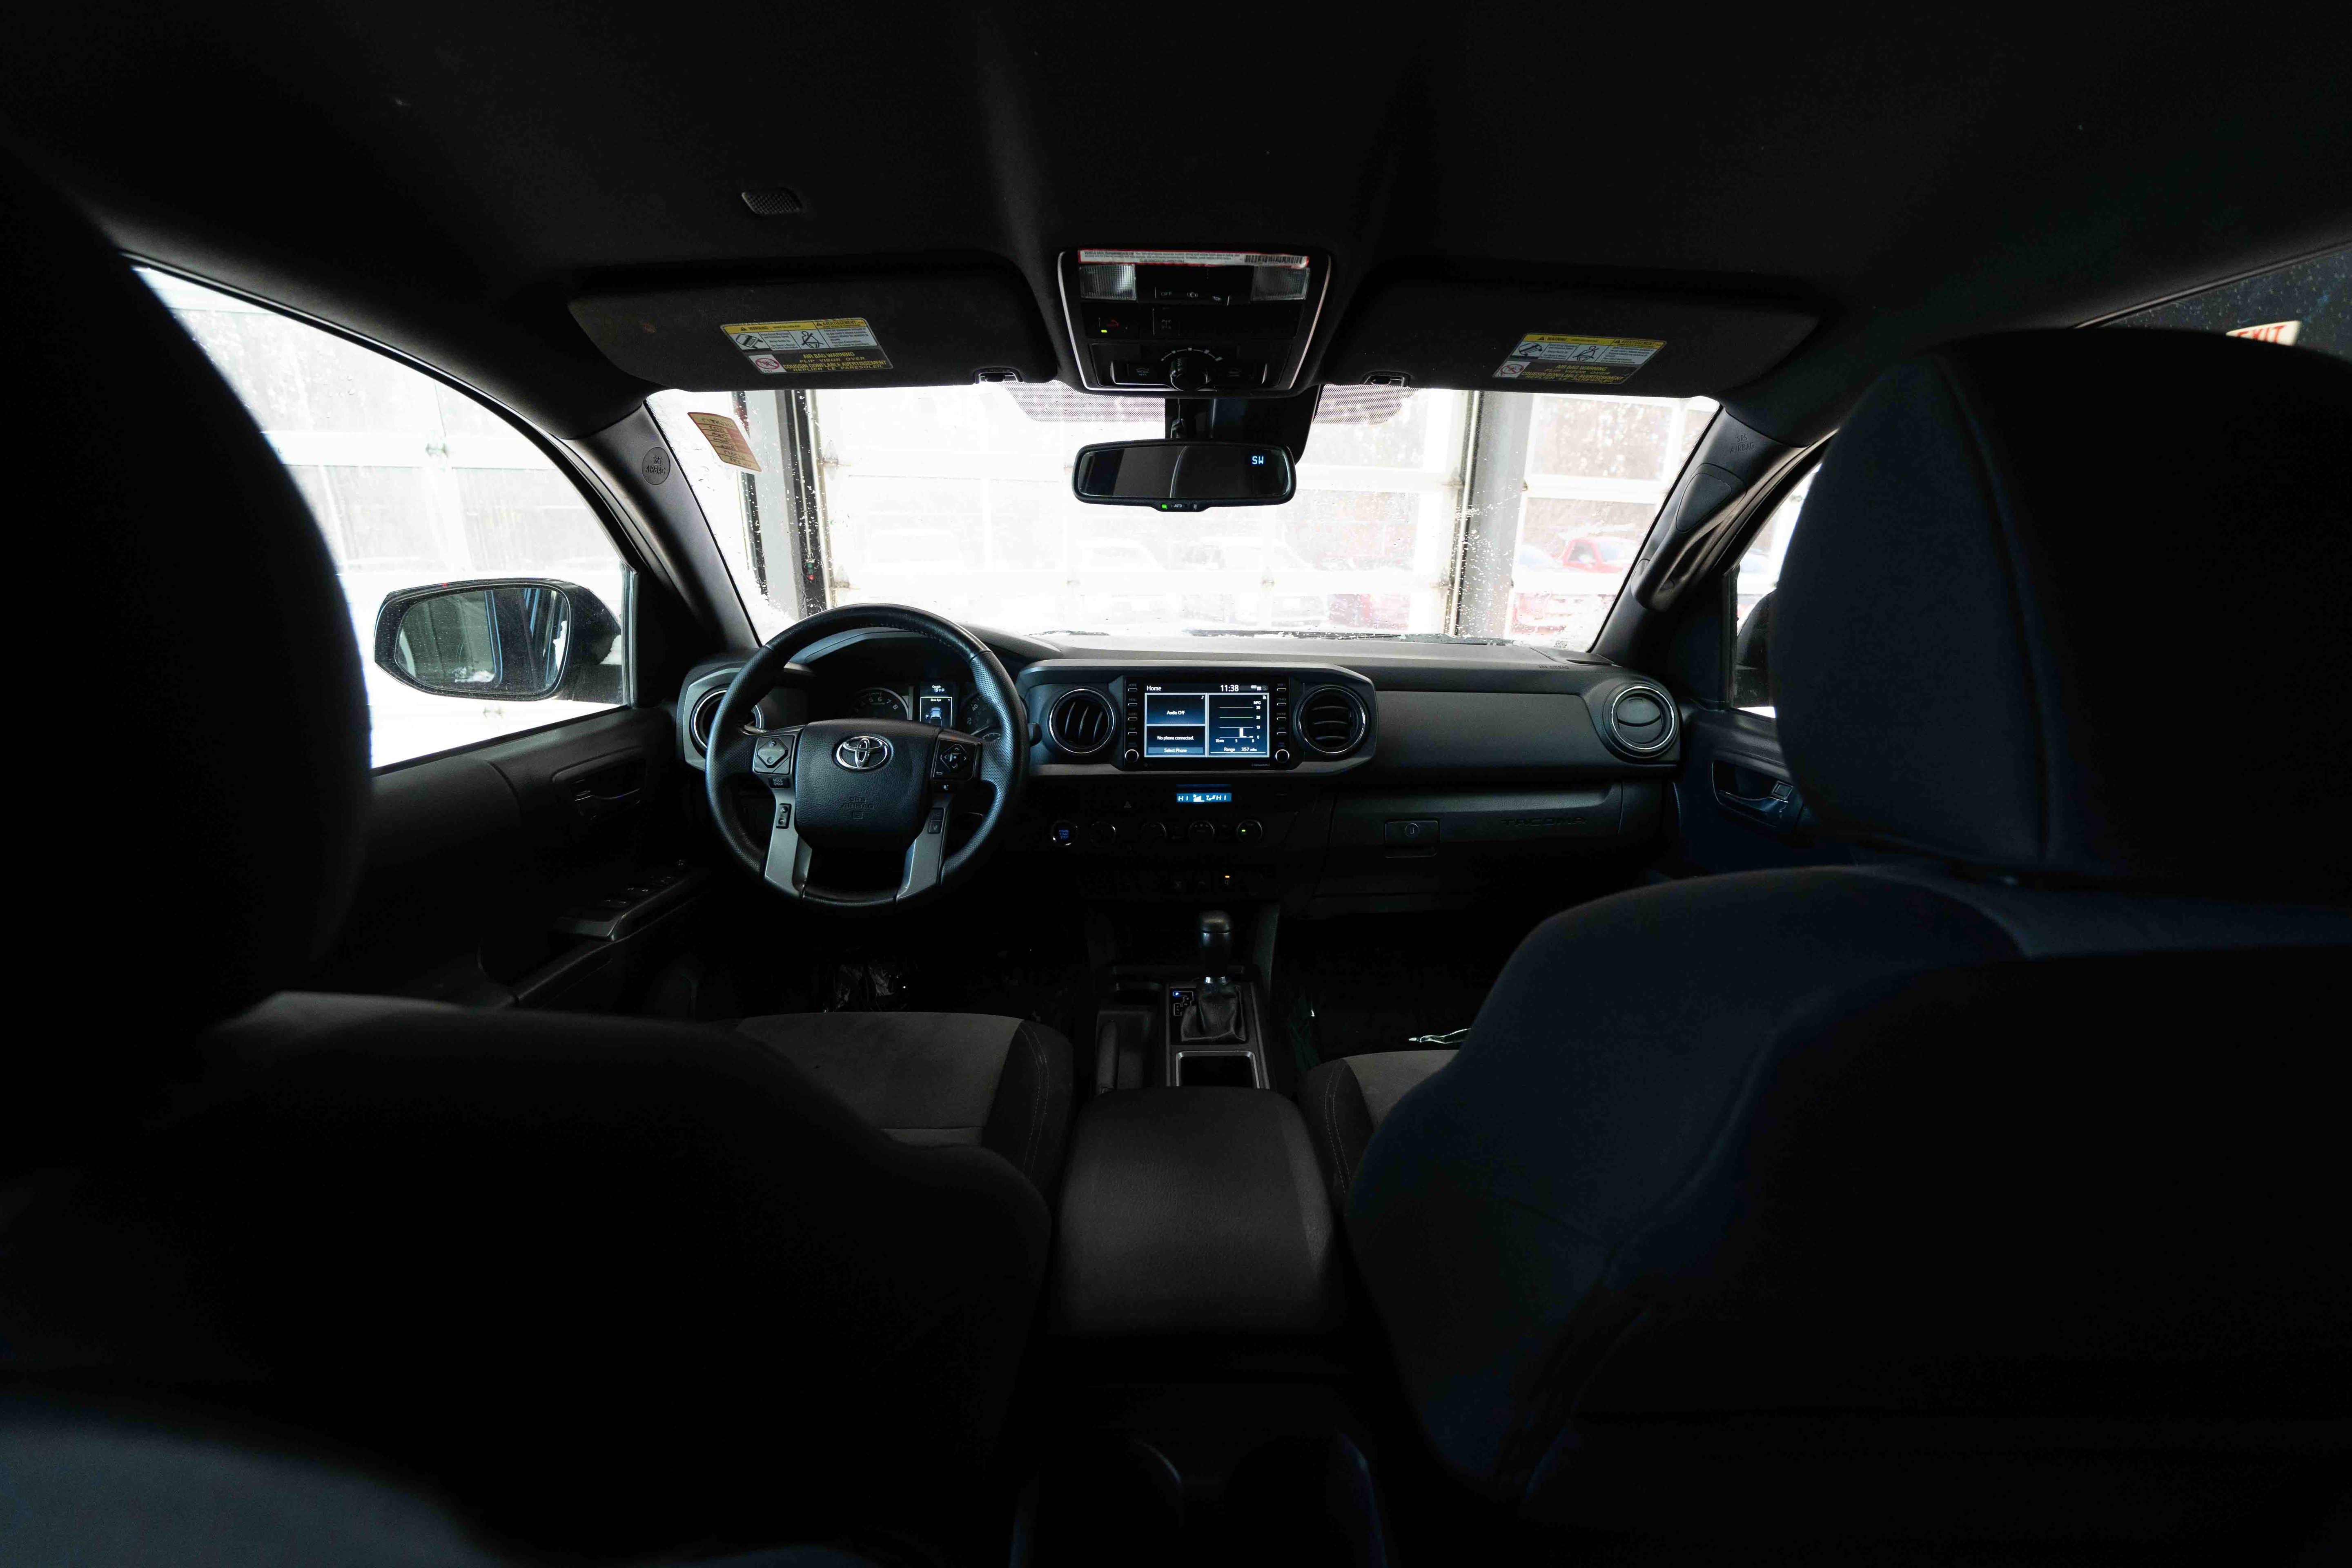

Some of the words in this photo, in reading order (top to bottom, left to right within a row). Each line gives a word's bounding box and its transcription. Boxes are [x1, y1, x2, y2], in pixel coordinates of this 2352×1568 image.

[2237, 325, 2286, 343] XIT
[1737, 433, 1747, 442] SRS
[1730, 442, 1755, 454] AIRBAG
[1252, 456, 1264, 464] SW
[645, 465, 666, 474] AIRBAG
